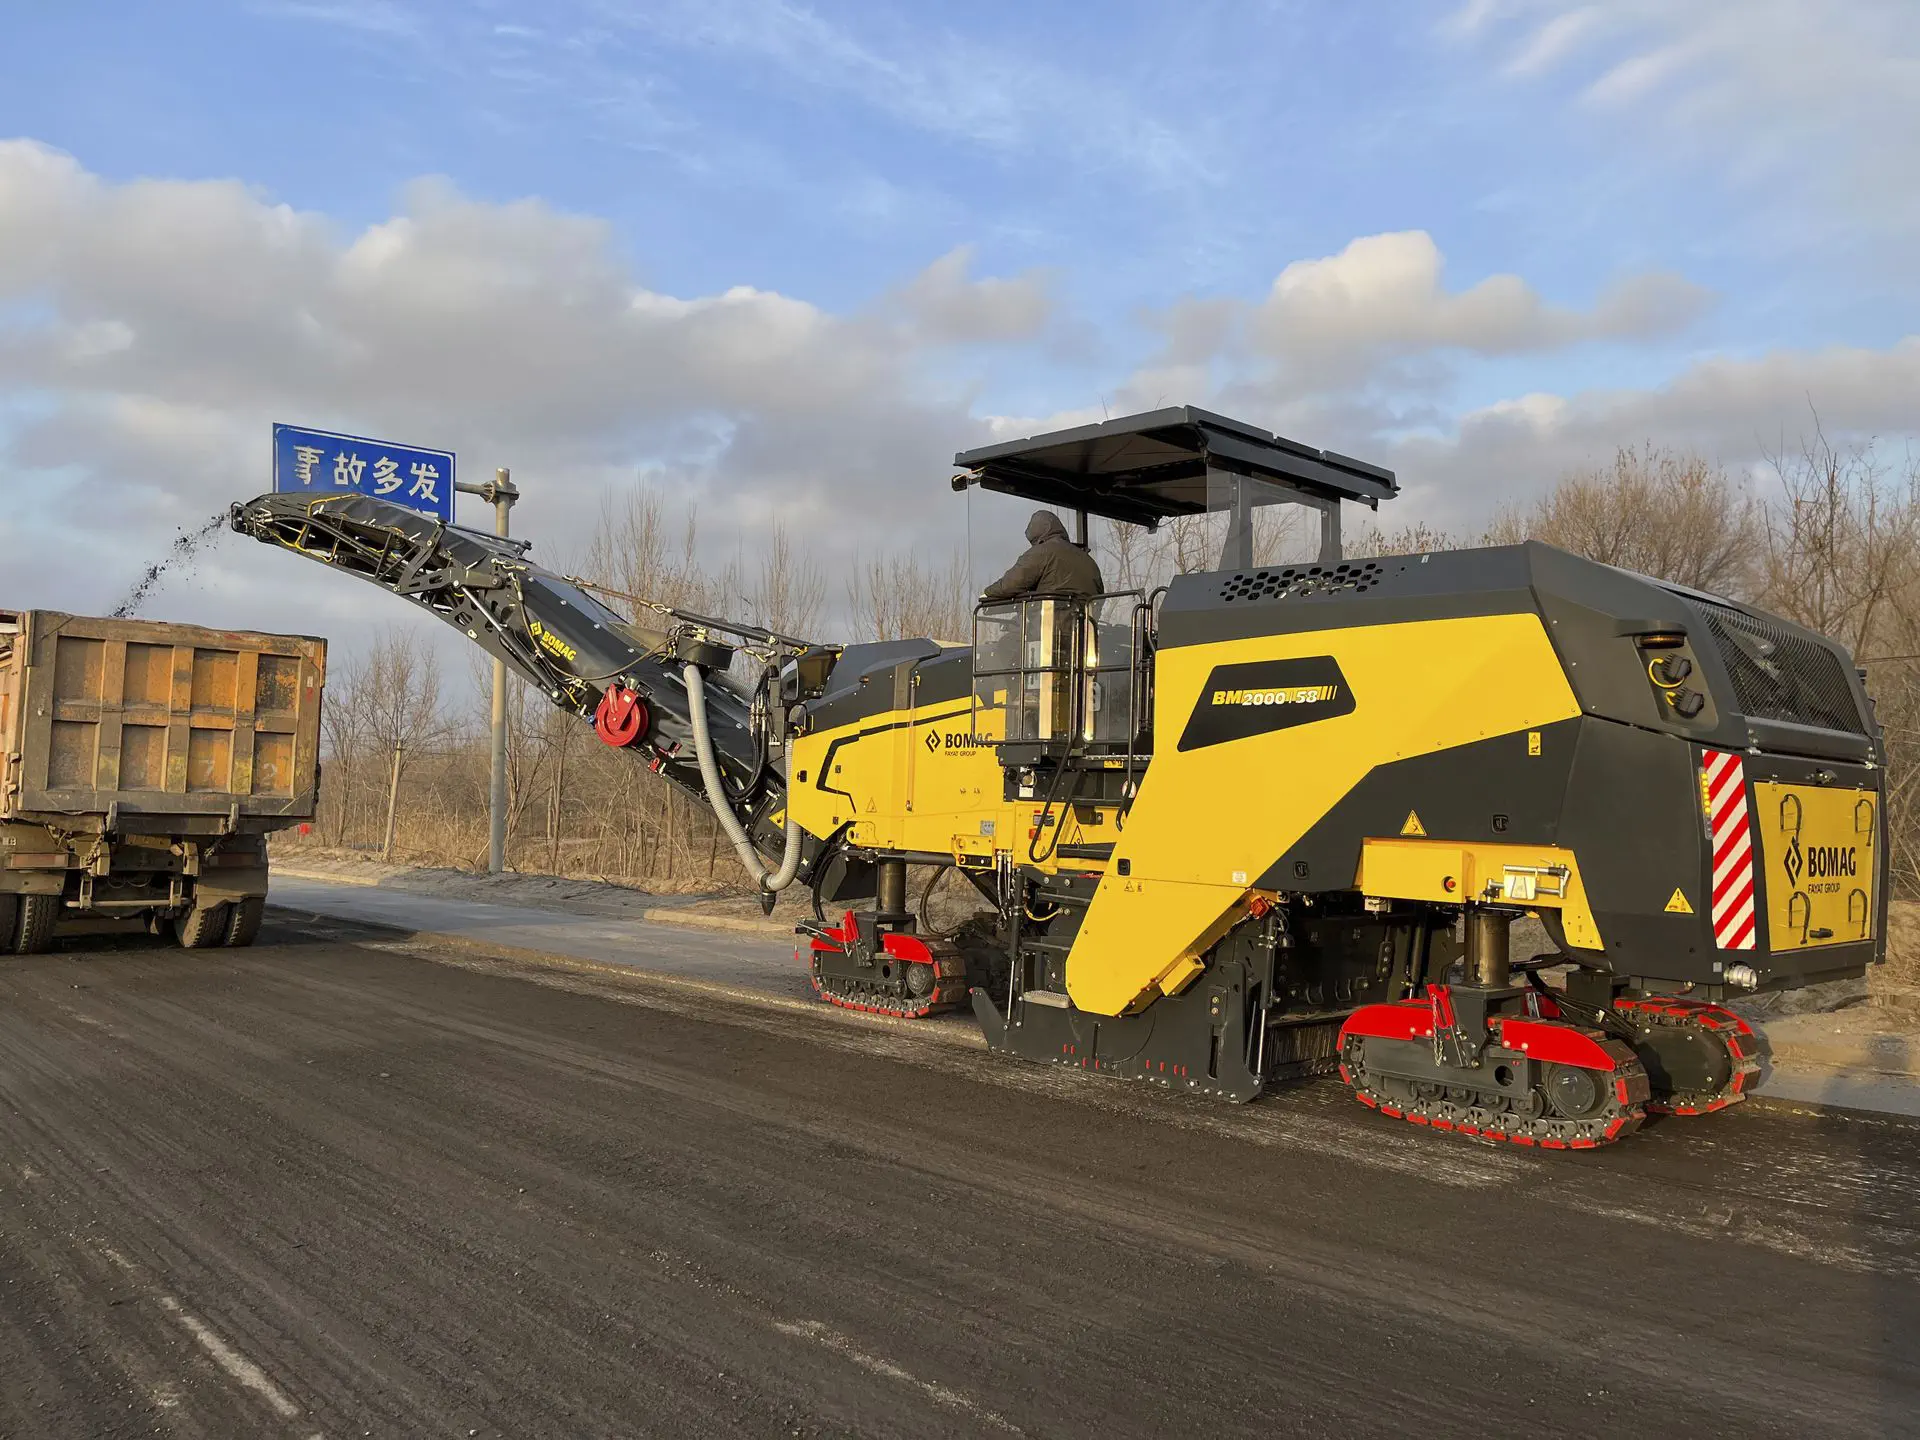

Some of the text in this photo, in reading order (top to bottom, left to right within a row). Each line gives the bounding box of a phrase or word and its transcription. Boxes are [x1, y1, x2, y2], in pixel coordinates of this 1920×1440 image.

[293, 444, 440, 504] 事故多发
[541, 630, 577, 661] BOMAG
[1808, 846, 1856, 877] BOMAG
[1808, 882, 1841, 894] FAYAT GROUP
